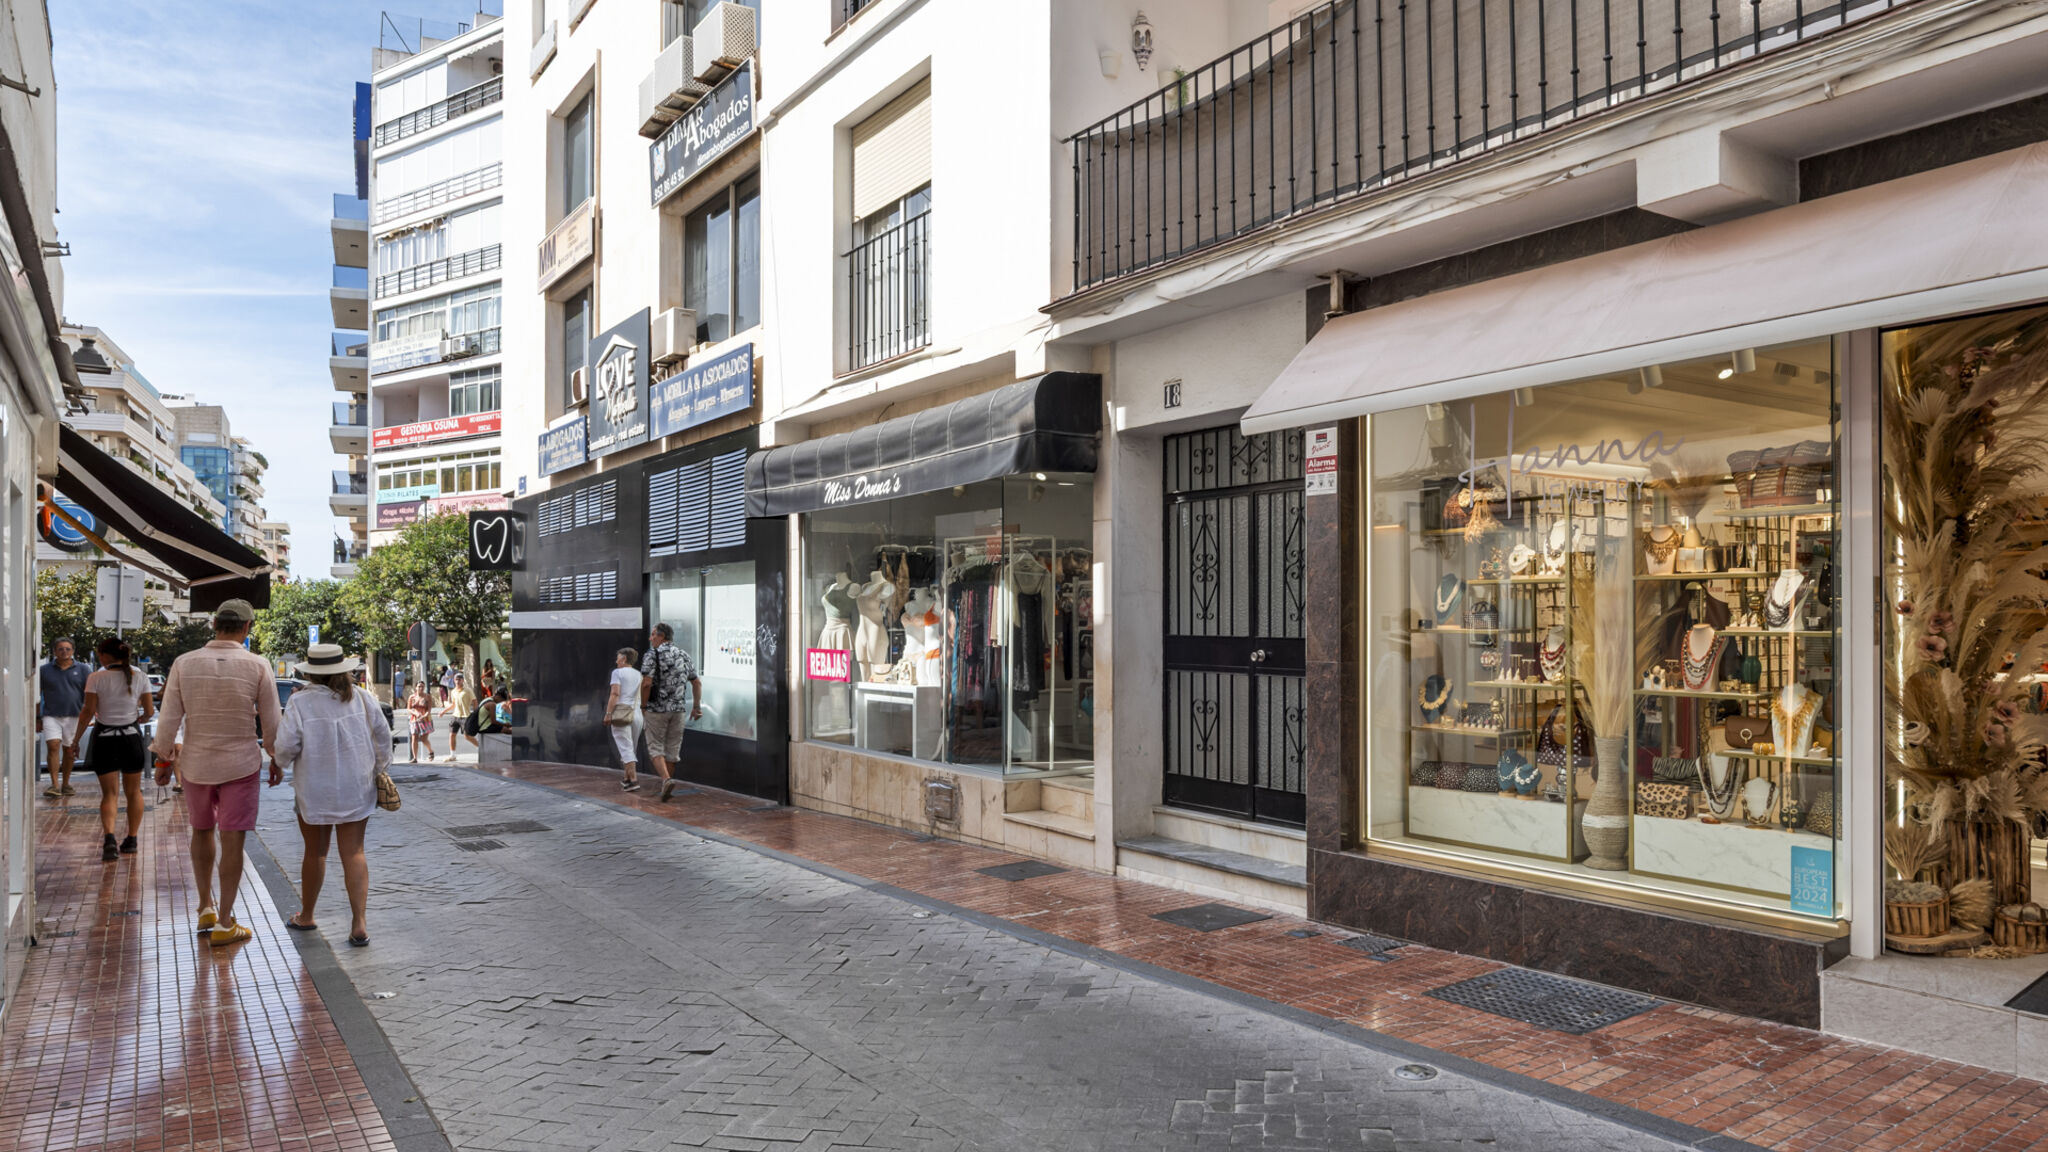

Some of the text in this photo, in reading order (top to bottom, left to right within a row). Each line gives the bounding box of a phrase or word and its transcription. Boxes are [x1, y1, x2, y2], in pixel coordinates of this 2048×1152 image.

[667, 105, 704, 152] DIMAR
[684, 94, 749, 158] Abogados
[596, 350, 636, 400] LOVE
[702, 353, 748, 388] ASOCIADOS
[1166, 385, 1180, 407] 18
[401, 422, 433, 436] GESTORIA
[433, 418, 459, 431] OSUNA
[546, 421, 584, 448] ABOGADOS
[1458, 390, 1685, 519] Hanna
[824, 473, 901, 504] Miss Donna's
[1537, 475, 1647, 509] JEWELRY
[311, 628, 317, 641] P
[810, 651, 847, 678] REBAJAS
[1794, 888, 1827, 904] 2024
